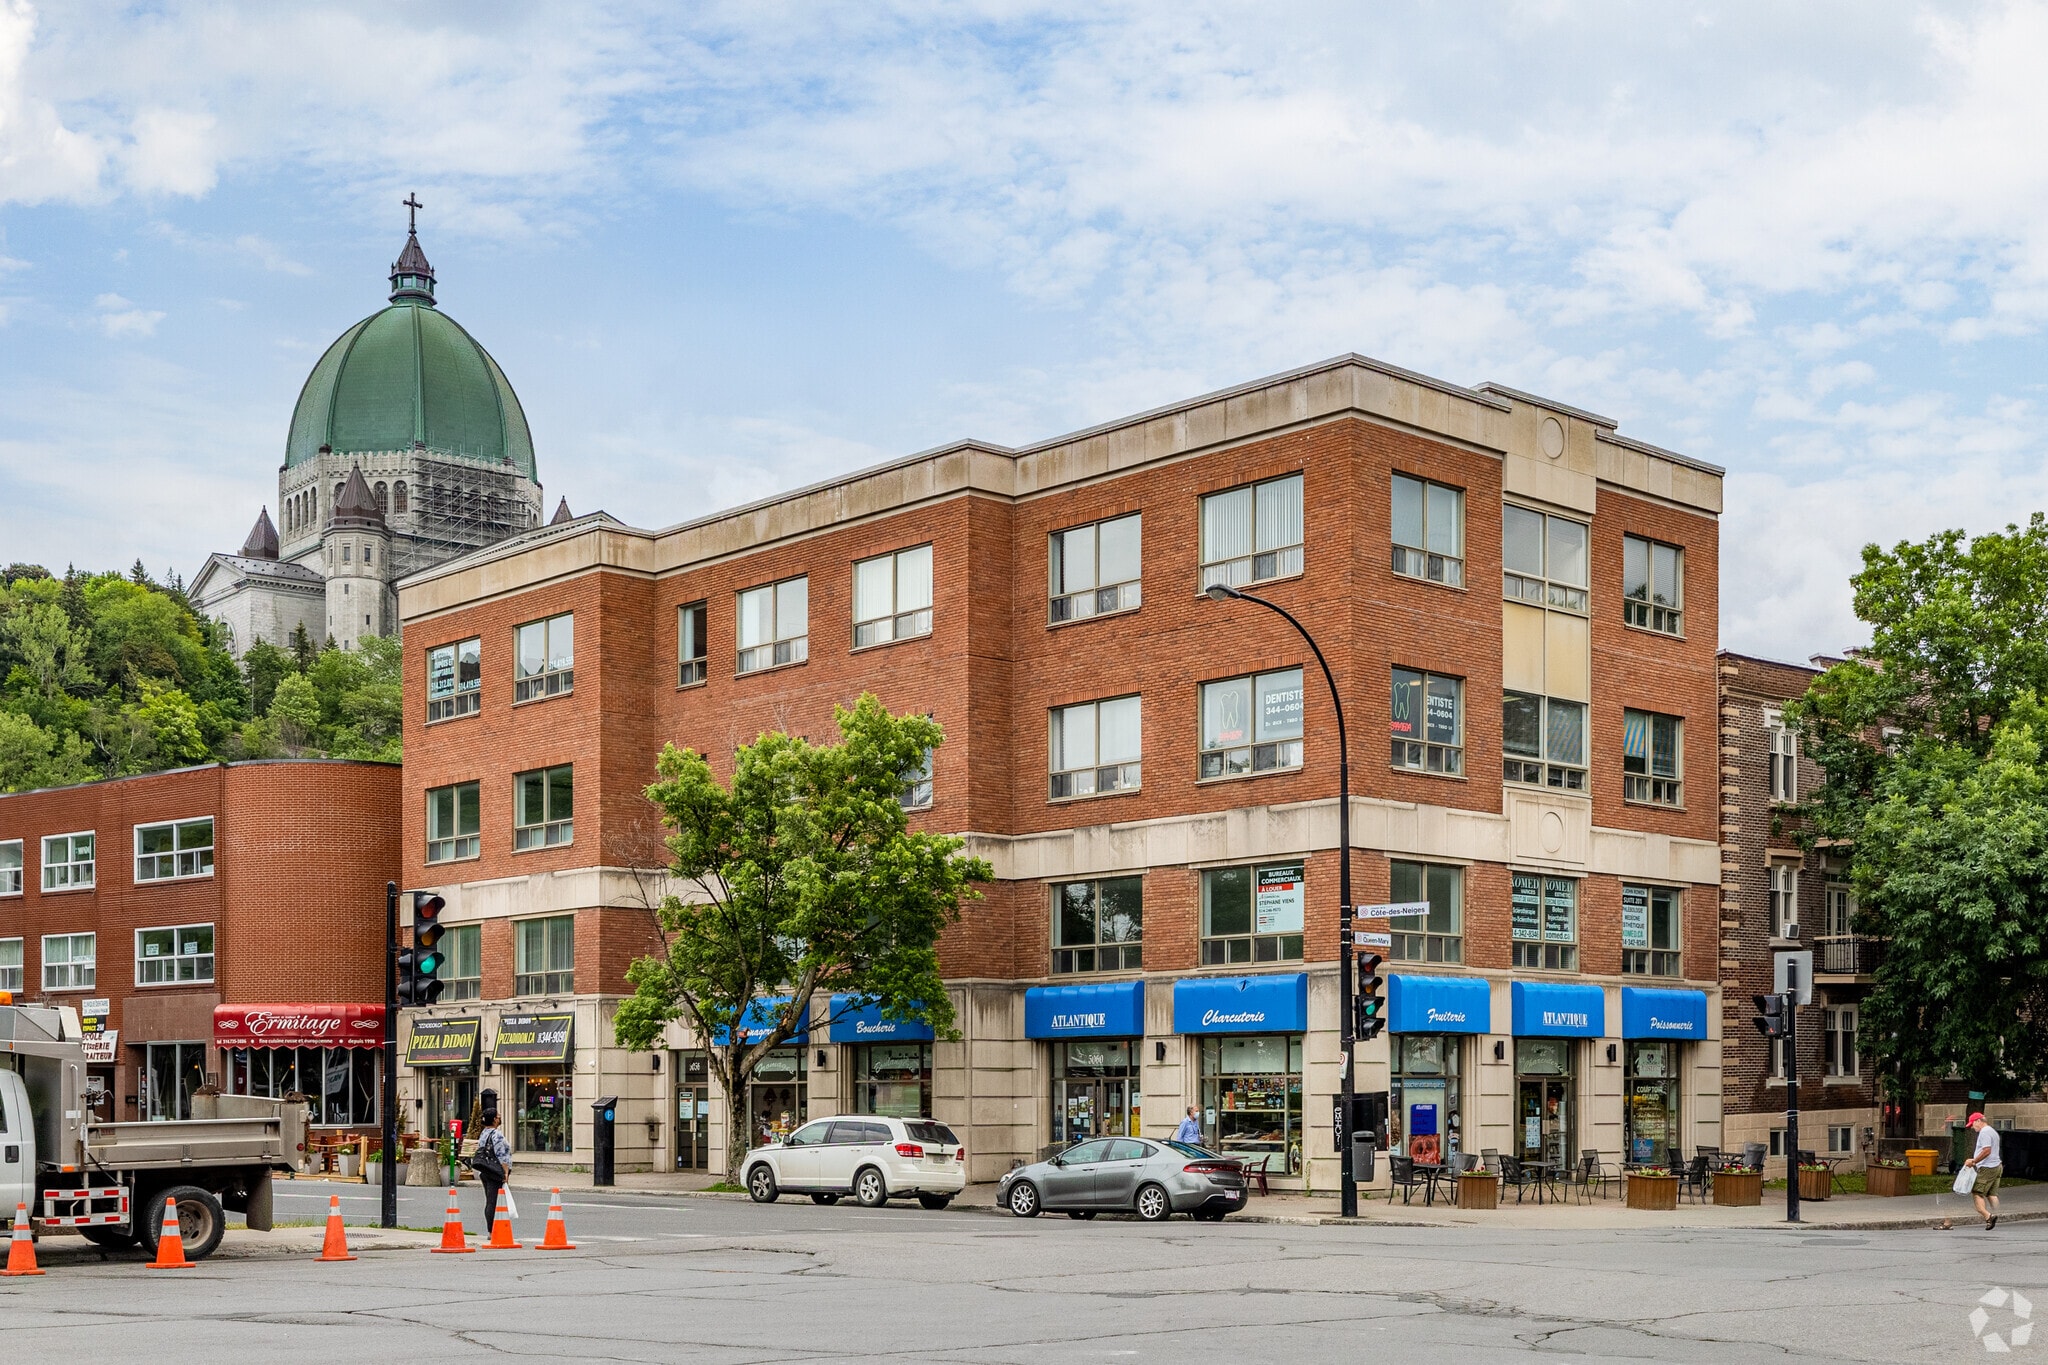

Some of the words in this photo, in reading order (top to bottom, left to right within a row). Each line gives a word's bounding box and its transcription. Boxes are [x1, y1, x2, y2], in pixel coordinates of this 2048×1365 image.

[1265, 689, 1303, 705] DENTISTE
[1427, 695, 1453, 710] ENTISTE
[1261, 875, 1302, 885] COMMERCIAUX
[1268, 869, 1295, 878] BUREAUX
[1051, 1013, 1106, 1029] ATLANTIQUE
[1202, 1009, 1265, 1026] Charcuterie
[1426, 1007, 1466, 1023] Fruiterie
[1543, 1011, 1588, 1028] ATLANTIQUE
[1650, 1016, 1694, 1030] Poissonnerie
[244, 1011, 341, 1037] Ermitage
[855, 1020, 896, 1034] Boucherie
[411, 1034, 440, 1050] PIZZA
[441, 1032, 474, 1049] DIDON
